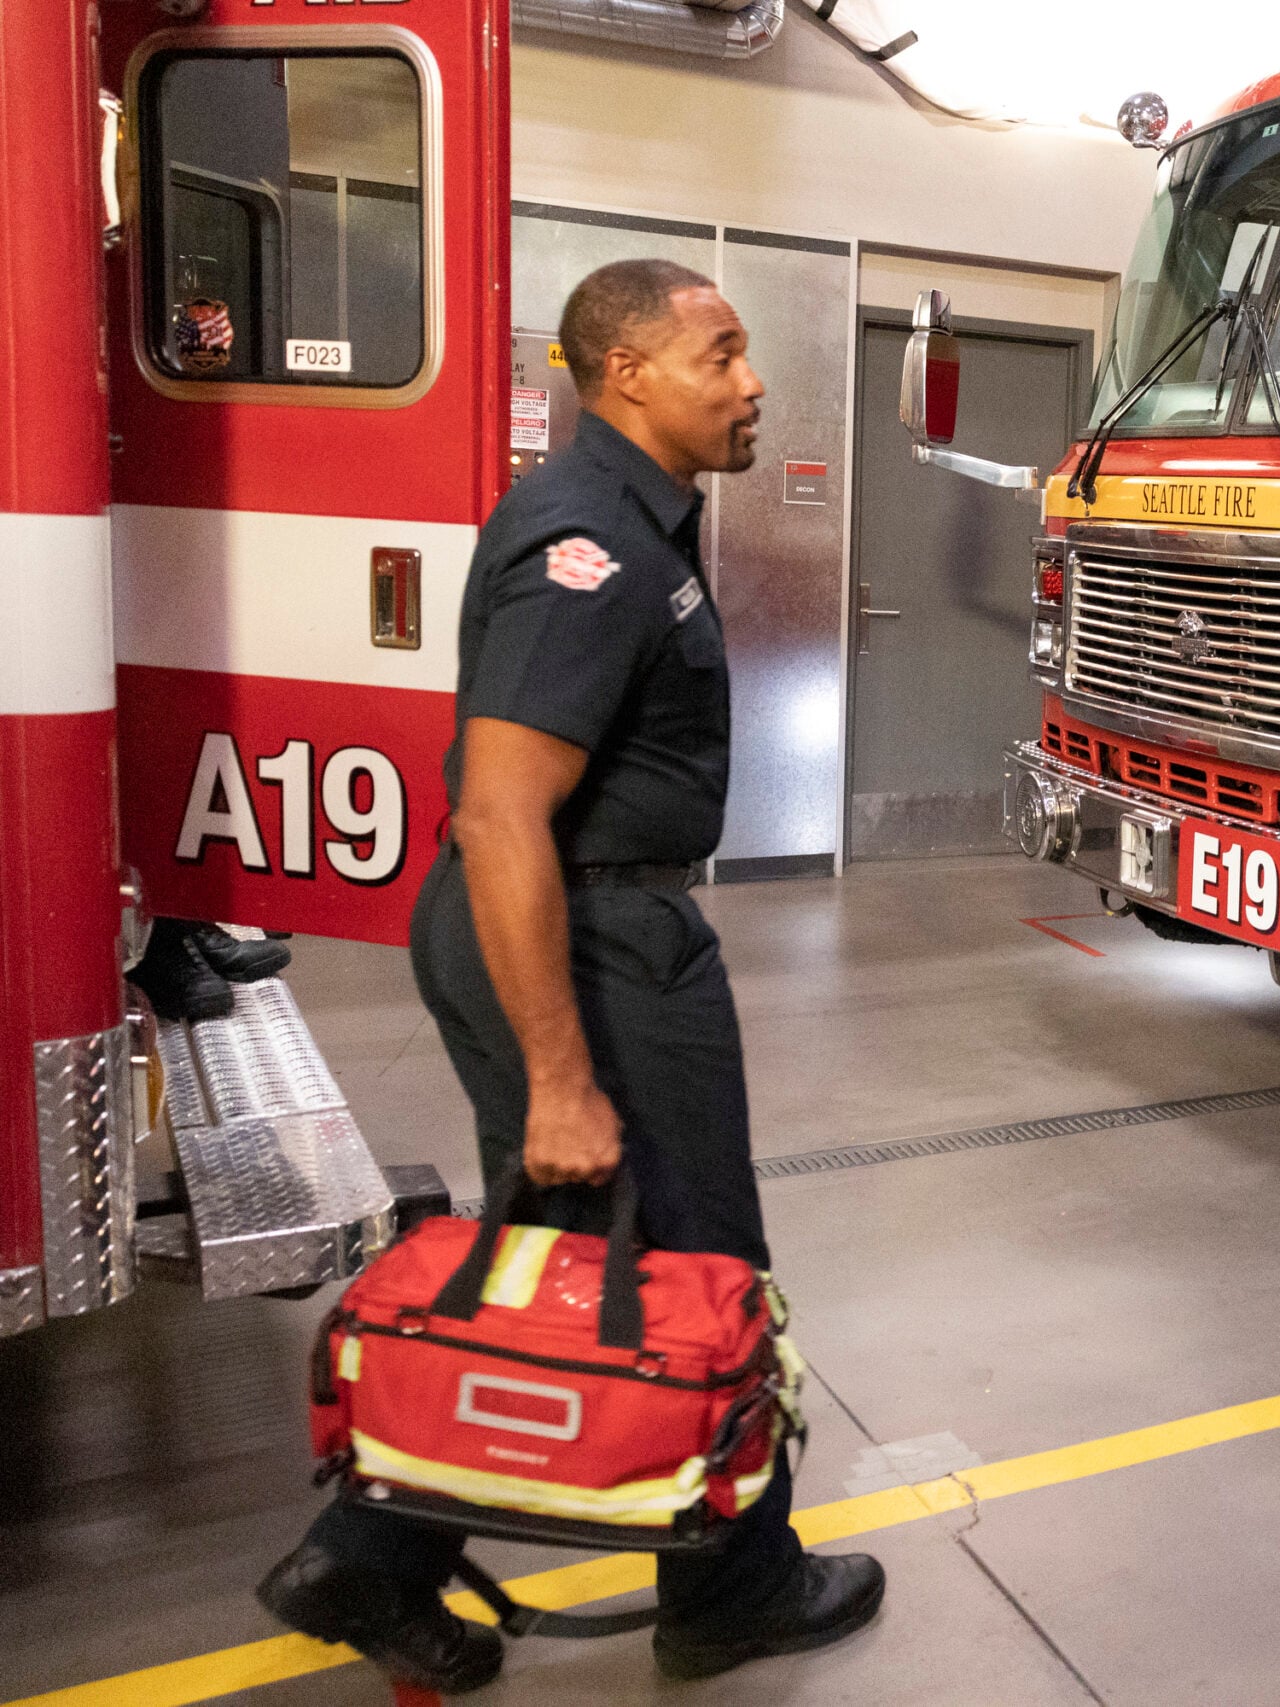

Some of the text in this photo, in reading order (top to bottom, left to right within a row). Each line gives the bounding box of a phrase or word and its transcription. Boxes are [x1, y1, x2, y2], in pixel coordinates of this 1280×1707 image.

[294, 345, 341, 366] F023
[550, 350, 567, 361] 44
[1142, 483, 1257, 518] SEATTLE FIRE
[174, 730, 409, 888] A19
[1191, 831, 1280, 935] E19
